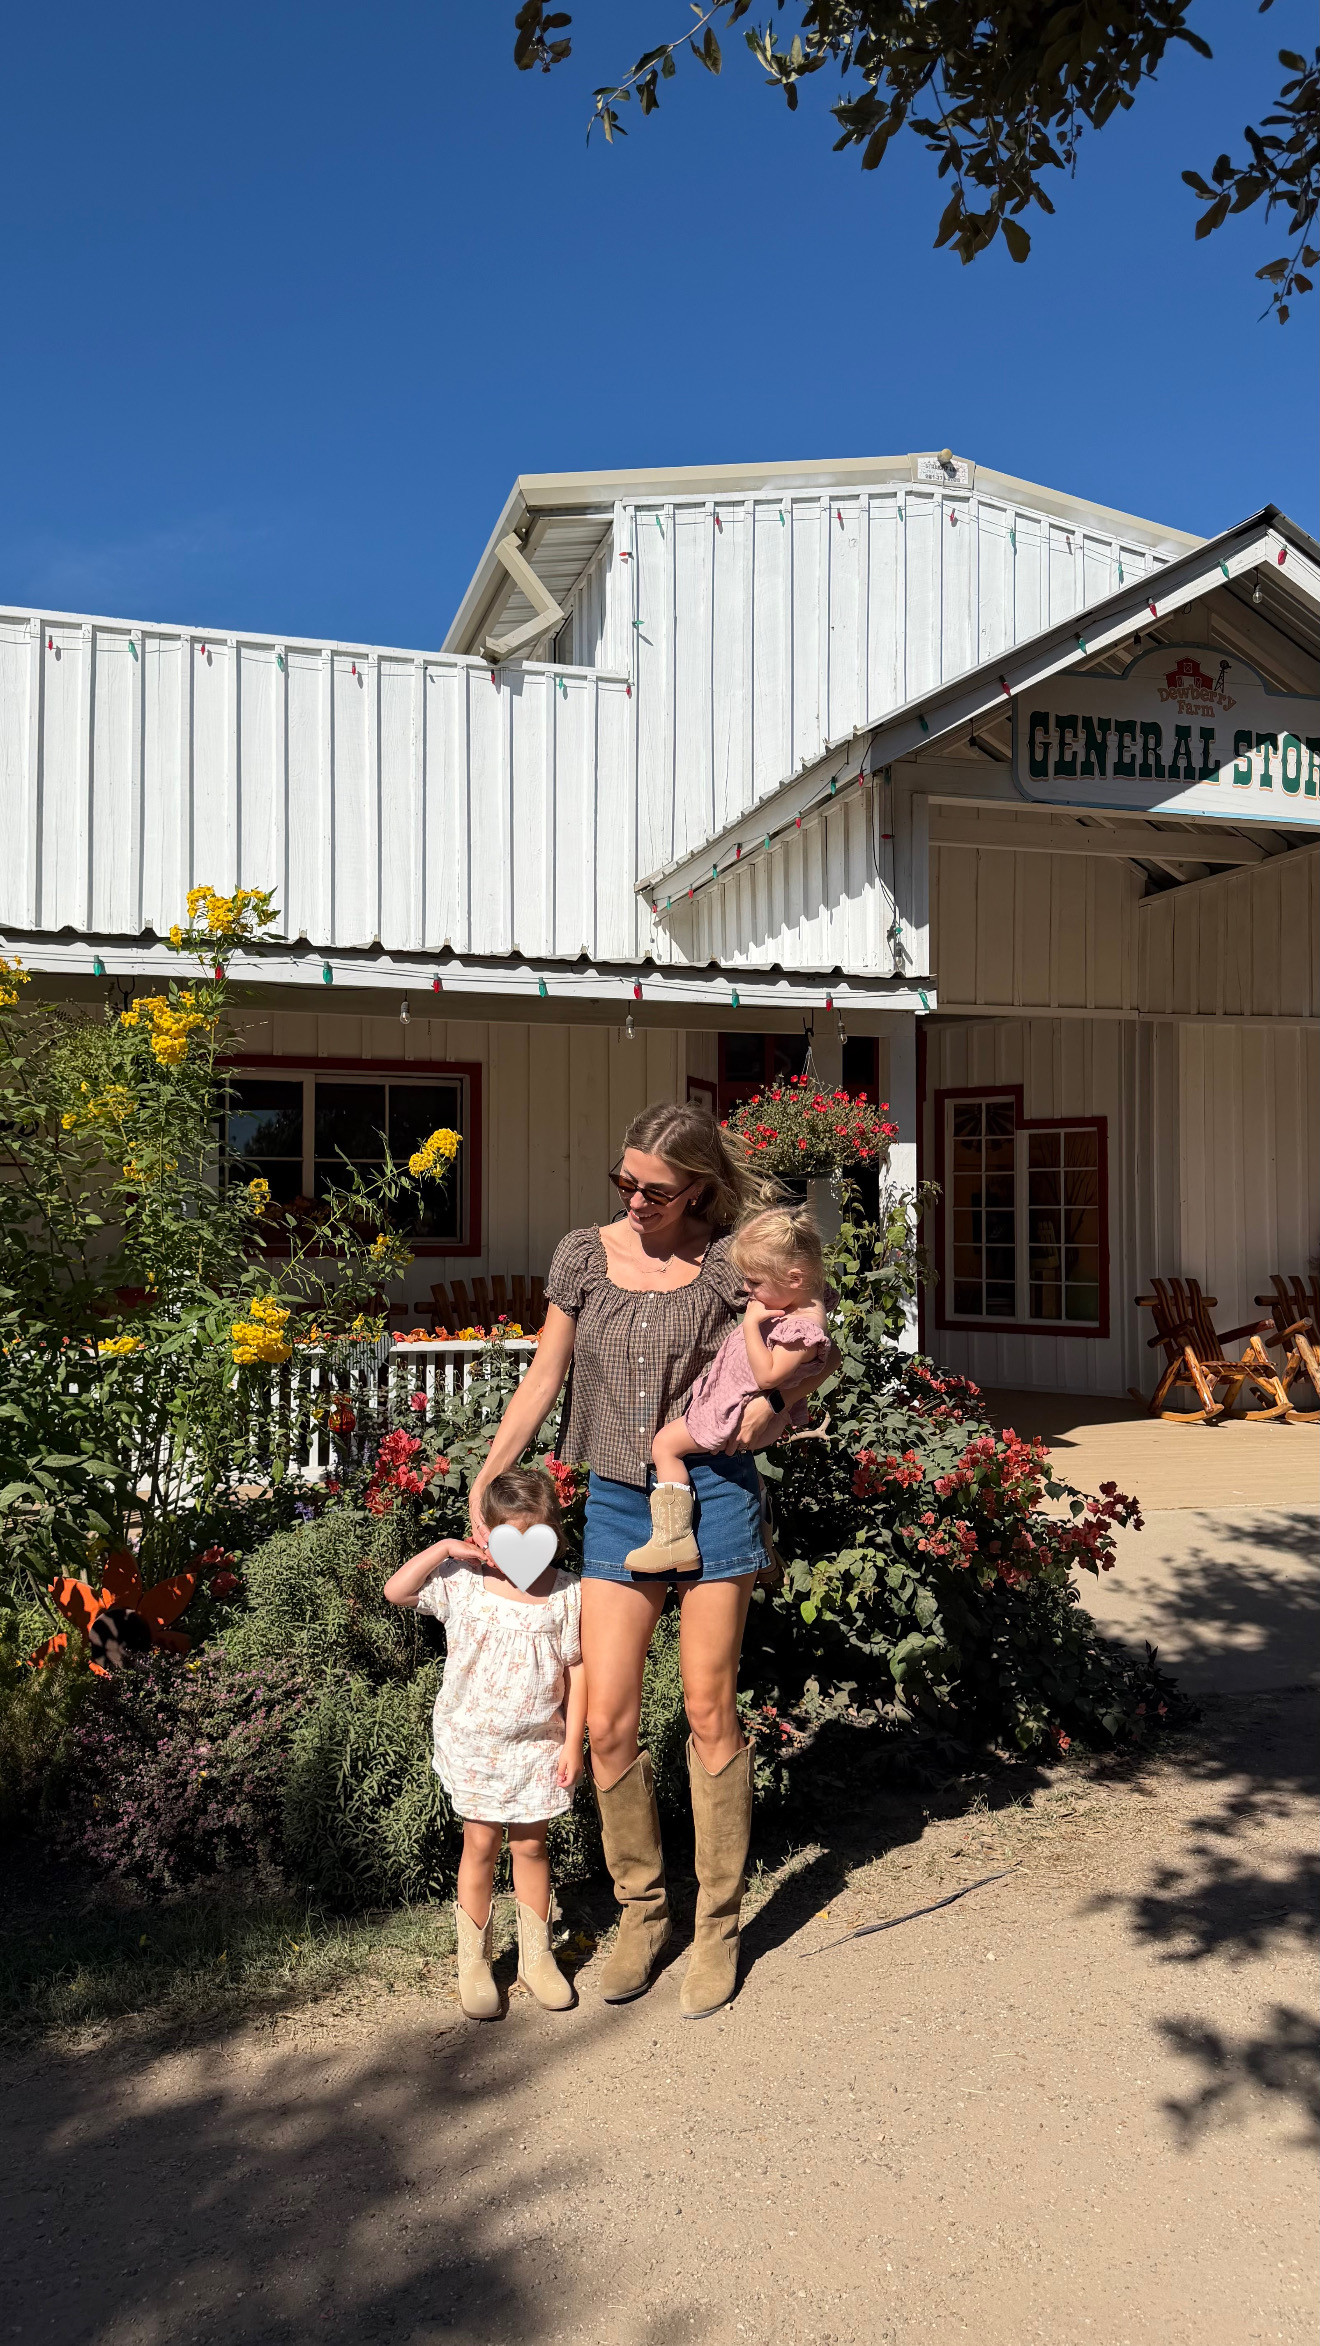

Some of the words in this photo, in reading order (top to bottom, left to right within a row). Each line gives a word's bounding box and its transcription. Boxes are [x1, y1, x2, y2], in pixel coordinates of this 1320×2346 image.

[1157, 685, 1237, 711] Dewberry
[1177, 700, 1215, 717] Farm
[1029, 711, 1221, 786] GENERAL
